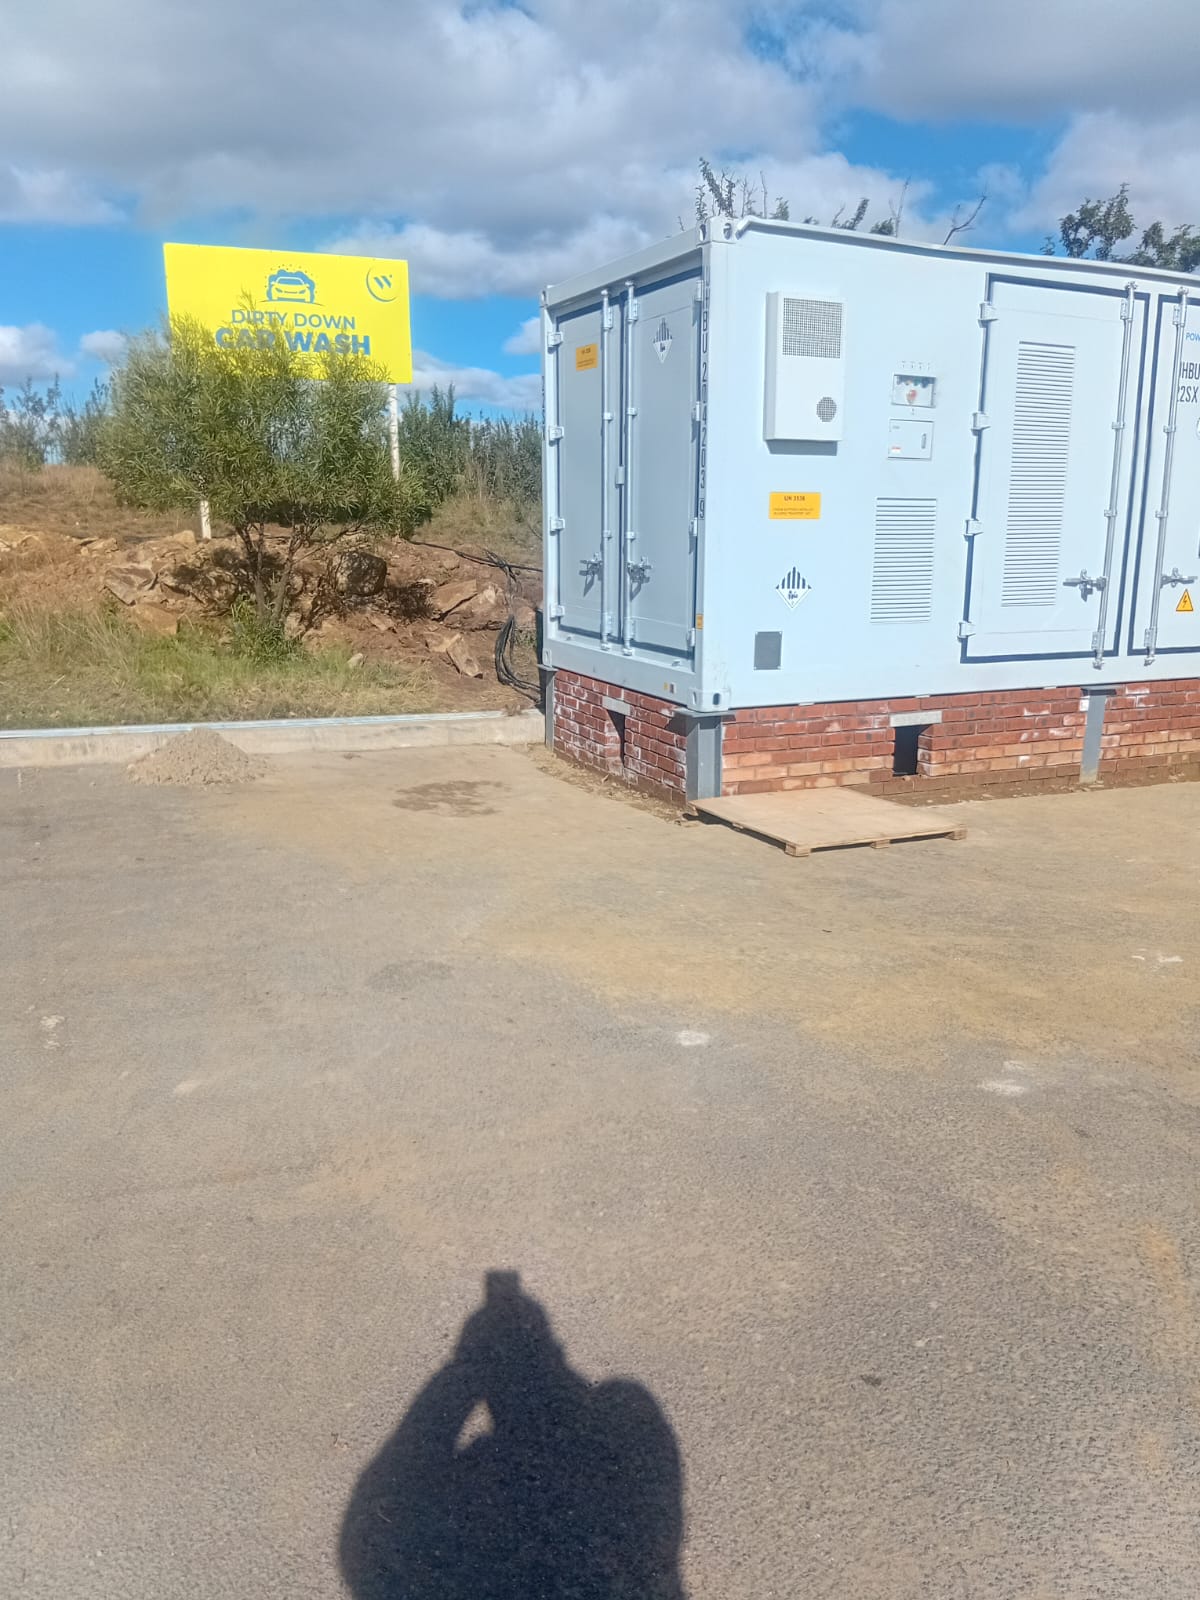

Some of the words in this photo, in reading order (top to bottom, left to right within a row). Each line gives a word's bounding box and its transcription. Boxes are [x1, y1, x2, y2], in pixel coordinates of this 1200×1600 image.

[231, 309, 288, 326] DIRTY
[294, 313, 356, 330] DOWN
[215, 327, 276, 351] CAR
[284, 331, 371, 356] WASH
